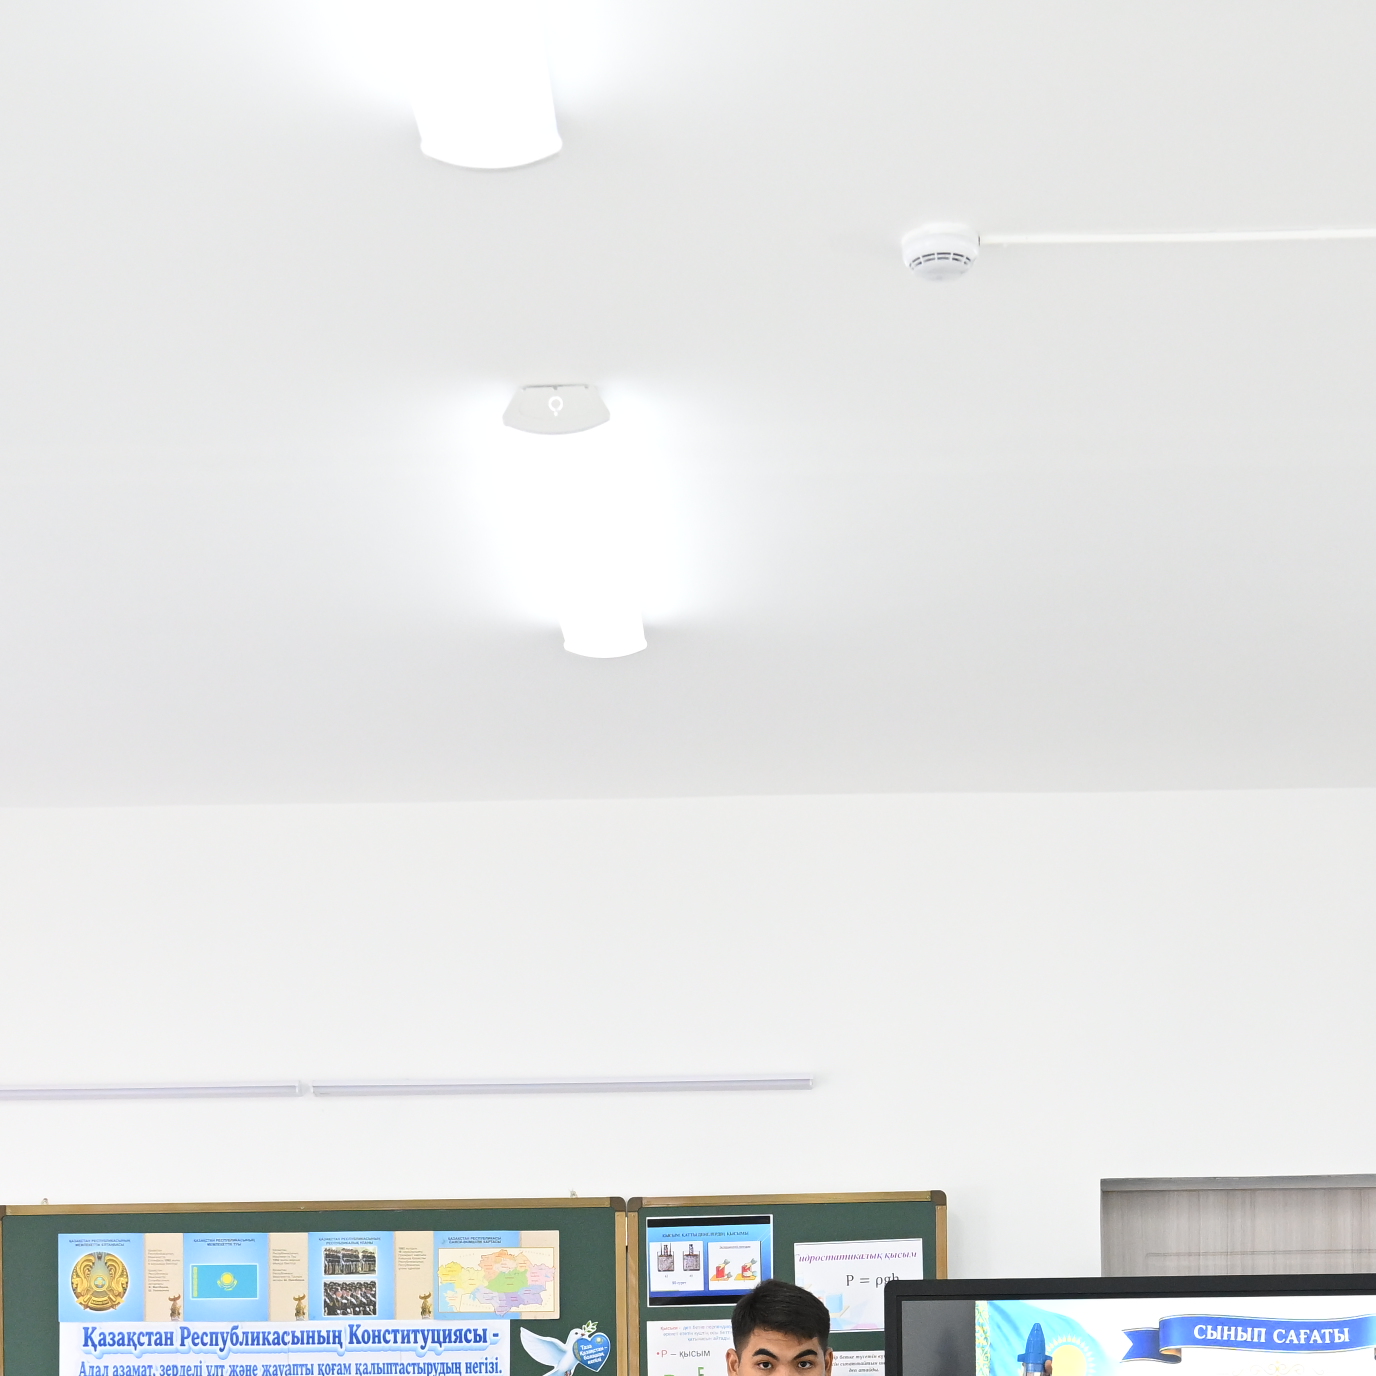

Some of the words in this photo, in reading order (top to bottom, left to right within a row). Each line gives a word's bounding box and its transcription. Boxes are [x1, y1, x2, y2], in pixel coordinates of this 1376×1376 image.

[795, 1252, 883, 1264] идростатикалық
[884, 1251, 917, 1261] қысым
[82, 1325, 174, 1352] Қазақстан
[179, 1324, 342, 1352] Республикасының
[348, 1323, 488, 1350] Конституциясы
[1193, 1323, 1268, 1343] СЫНЫП
[1272, 1326, 1351, 1345] САҒАТЫ
[679, 1350, 711, 1359] ҚЫСЫМ
[229, 1362, 258, 1376] және
[464, 1356, 503, 1375] негізі.
